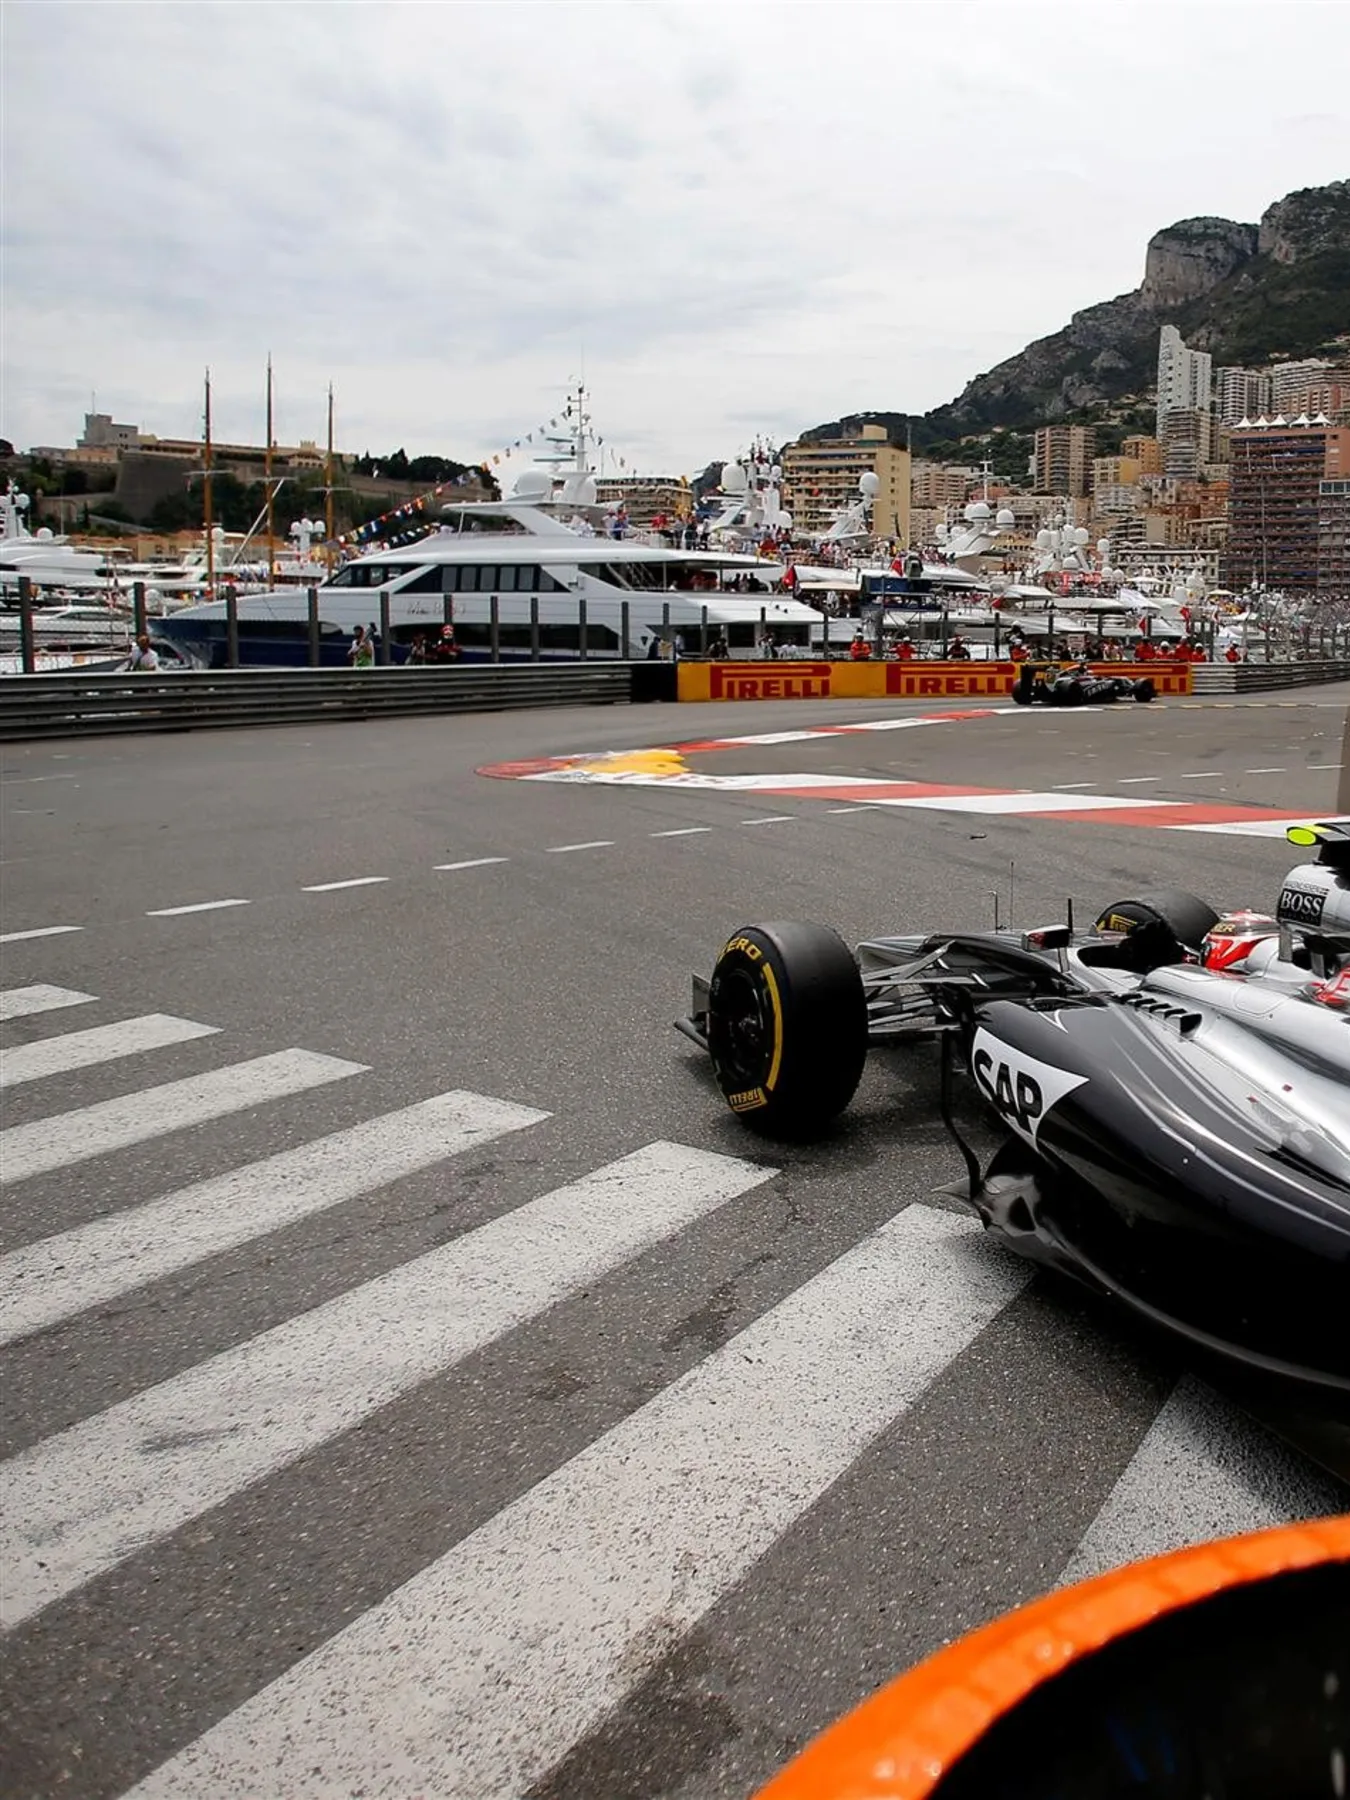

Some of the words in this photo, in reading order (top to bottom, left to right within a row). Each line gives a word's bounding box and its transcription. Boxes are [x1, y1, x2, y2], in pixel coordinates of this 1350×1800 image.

[709, 664, 832, 699] PIRELLI
[886, 663, 1016, 695] PIRELLI
[1280, 890, 1323, 917] BOSS
[974, 1048, 1044, 1135] SAP
